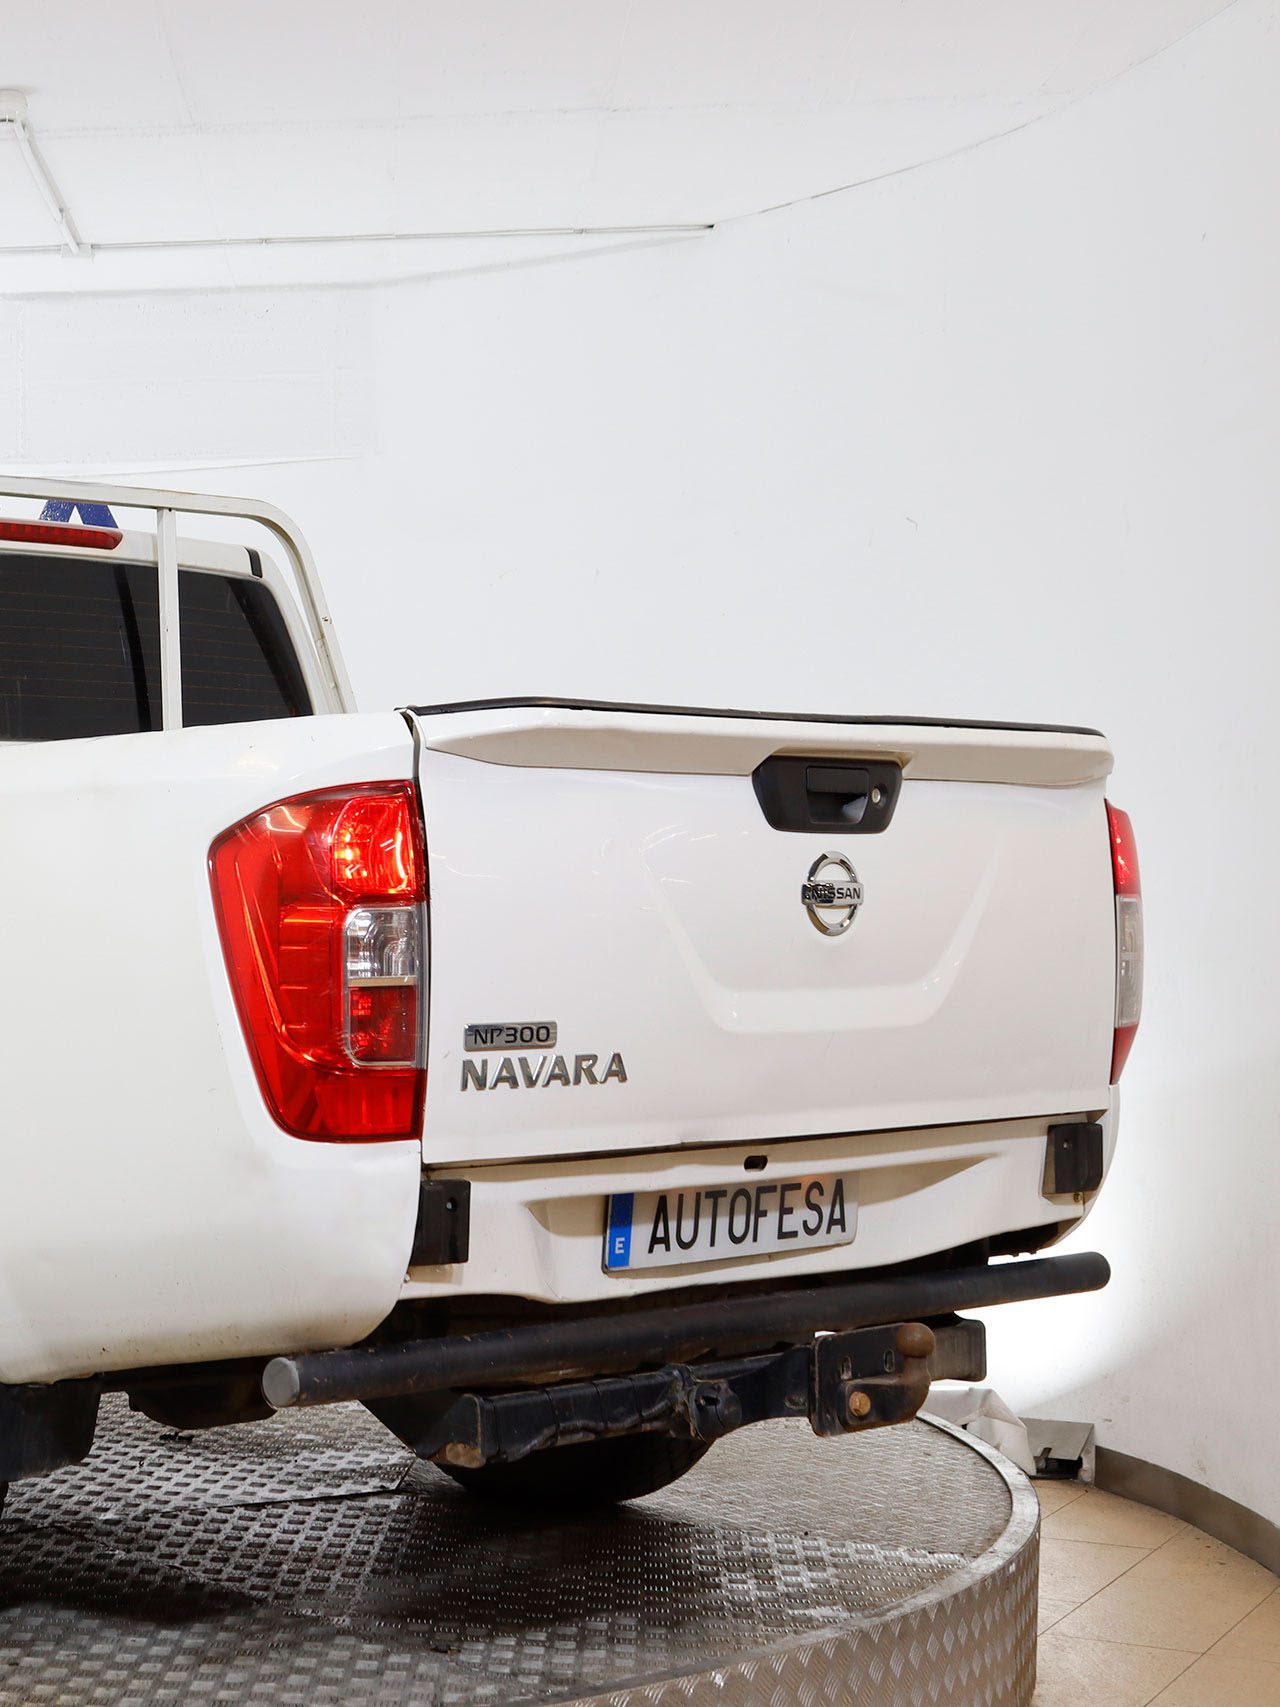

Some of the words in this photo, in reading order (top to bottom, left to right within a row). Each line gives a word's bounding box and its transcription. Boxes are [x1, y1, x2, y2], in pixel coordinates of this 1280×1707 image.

[811, 886, 861, 900] NISSAN
[473, 1025, 551, 1045] NP300
[461, 1052, 628, 1091] NAVARA
[615, 1236, 625, 1254] E
[648, 1178, 846, 1254] AUTOFESA
